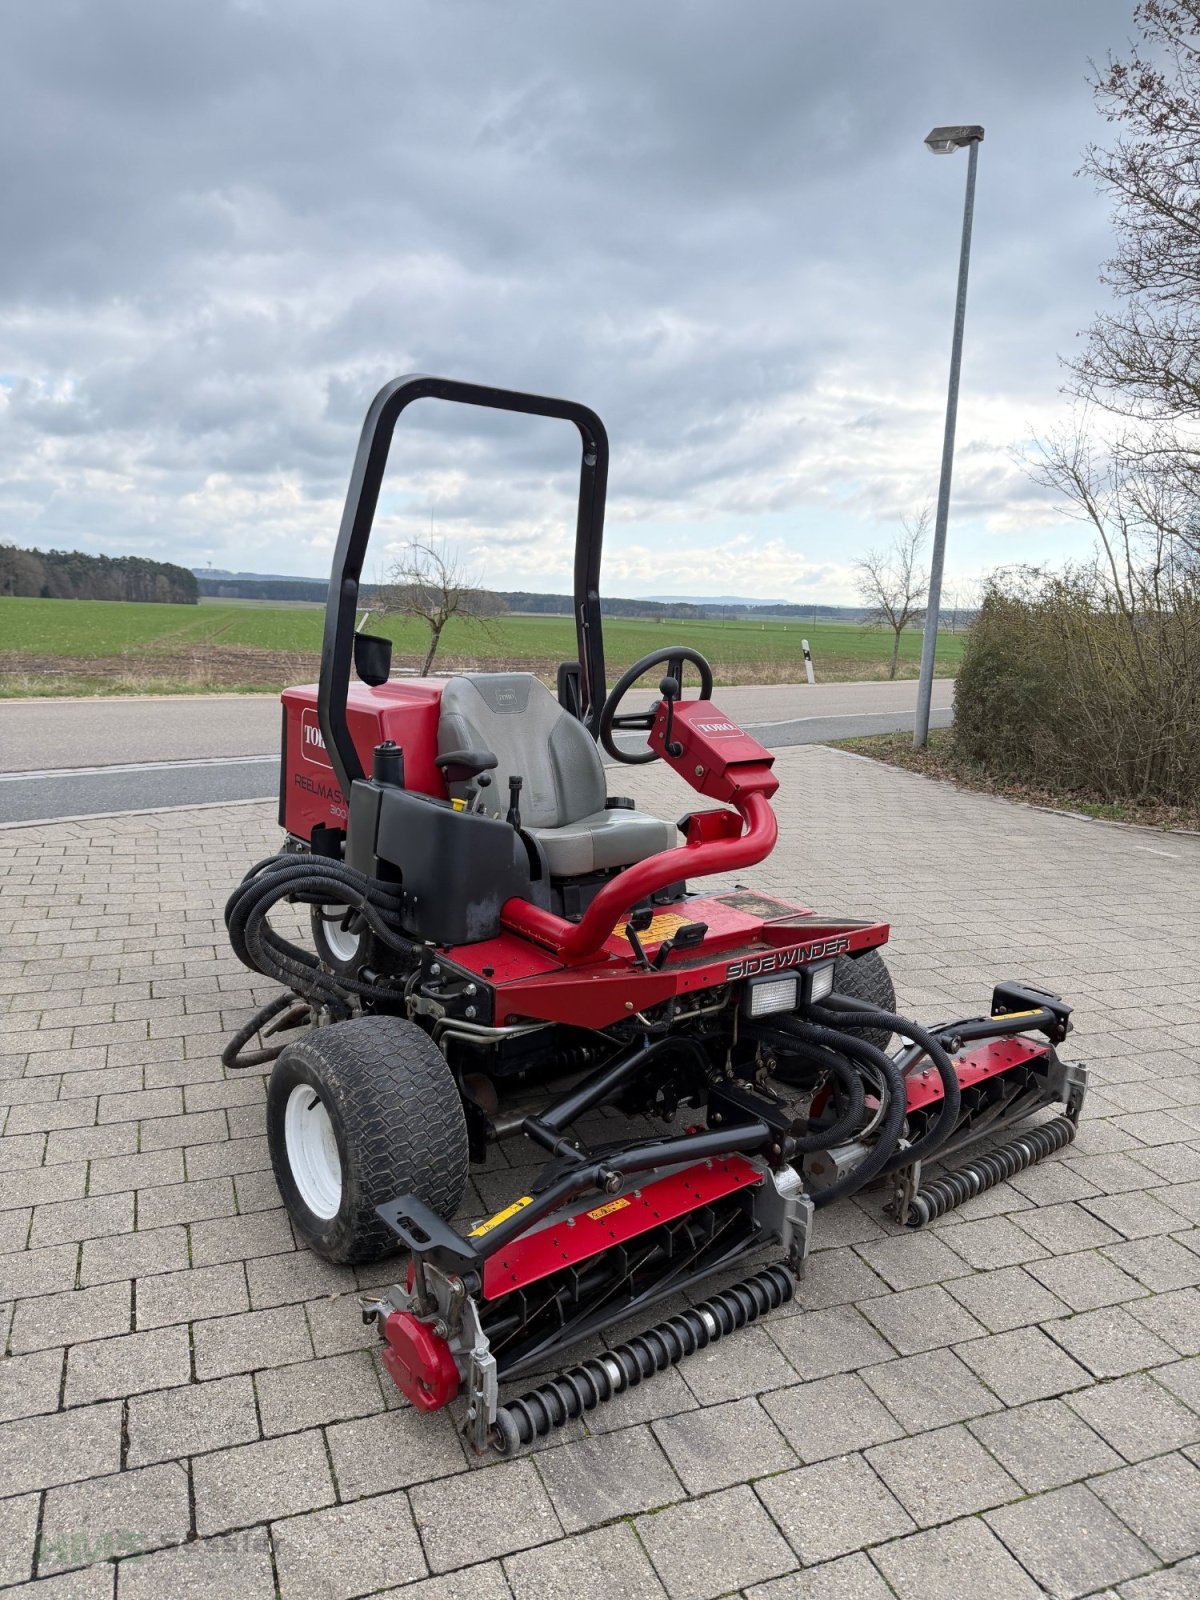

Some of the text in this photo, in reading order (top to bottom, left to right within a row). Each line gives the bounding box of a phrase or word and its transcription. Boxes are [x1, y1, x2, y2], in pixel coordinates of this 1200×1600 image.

[304, 724, 327, 749] TOR
[697, 723, 737, 732] TORO
[726, 939, 850, 981] SIDEWINDER
